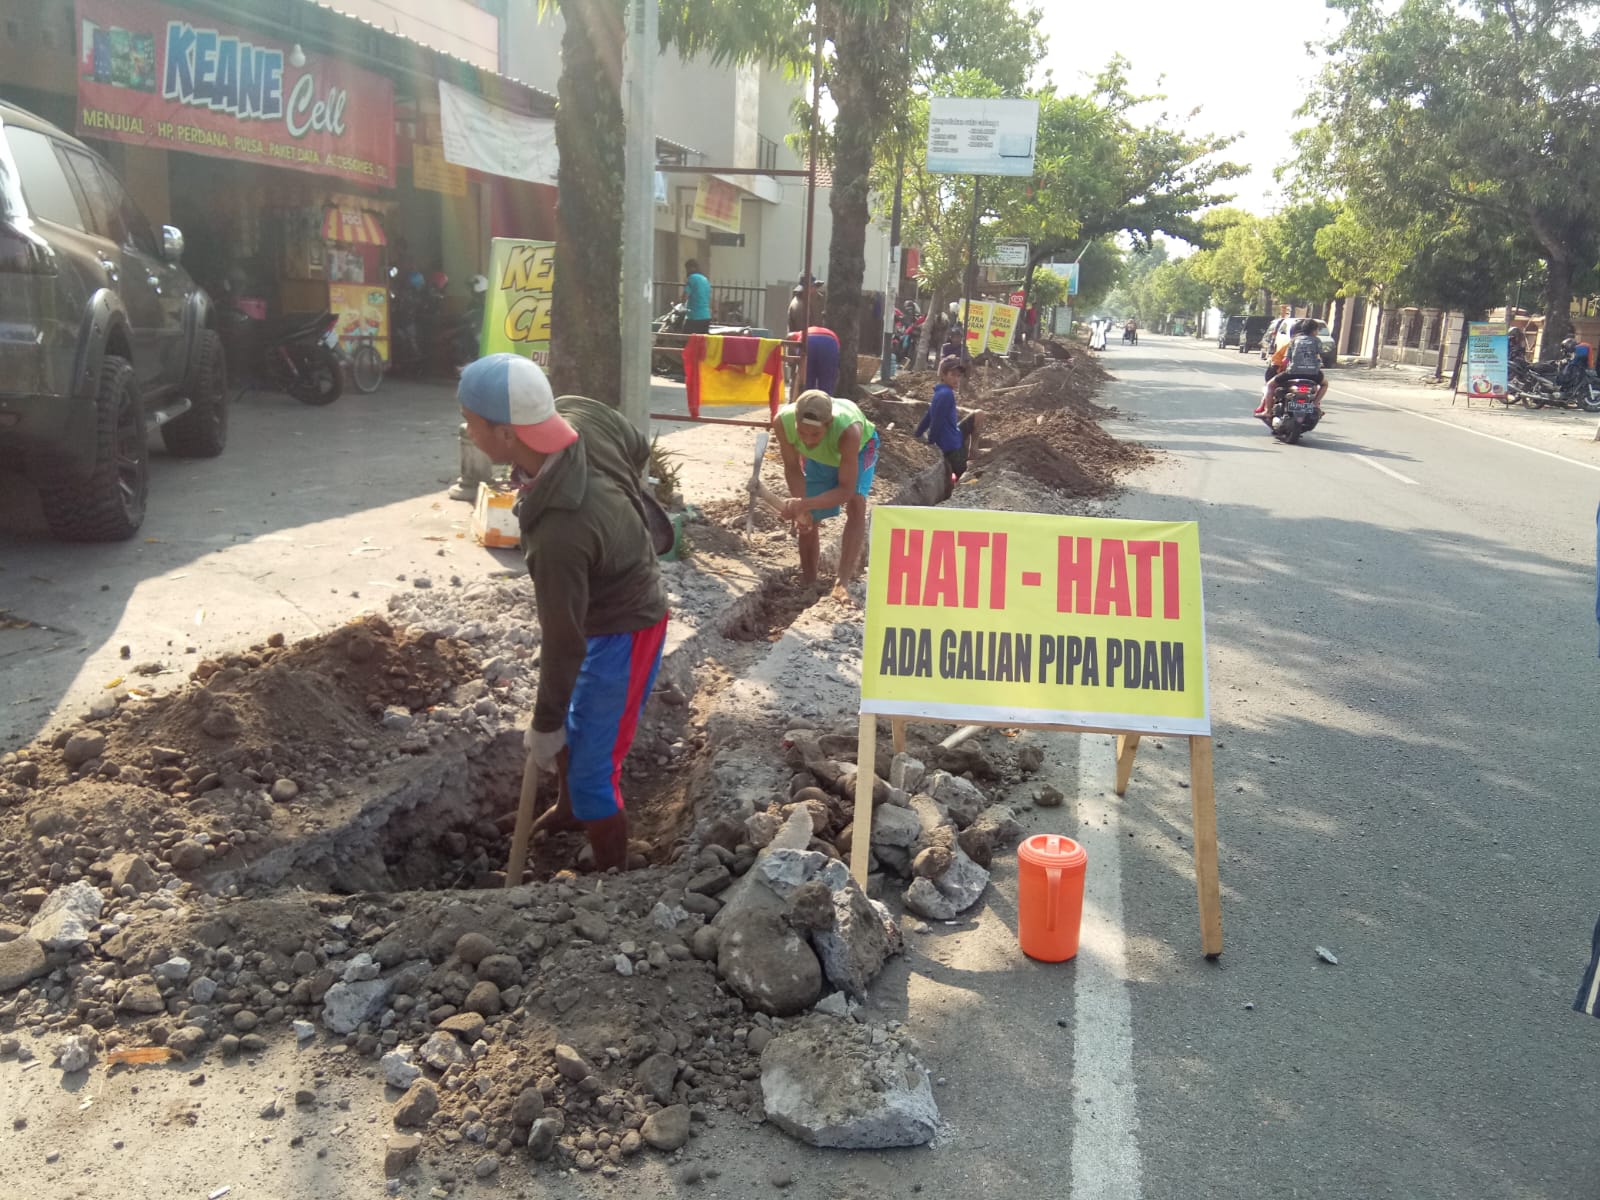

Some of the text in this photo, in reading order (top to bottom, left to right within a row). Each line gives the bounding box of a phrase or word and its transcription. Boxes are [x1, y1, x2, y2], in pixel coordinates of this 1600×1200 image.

[162, 21, 347, 137] KEANE Cell
[83, 110, 145, 134] MENJUAL
[157, 121, 174, 141] HP,
[177, 125, 232, 151] PERDANA,
[500, 245, 557, 293] KE
[504, 295, 553, 343] CE
[530, 350, 553, 368] PU
[886, 528, 1008, 610] HATI
[1056, 535, 1180, 620] HATI
[879, 626, 1185, 692] ADA GALIAN PIPA PDAM
